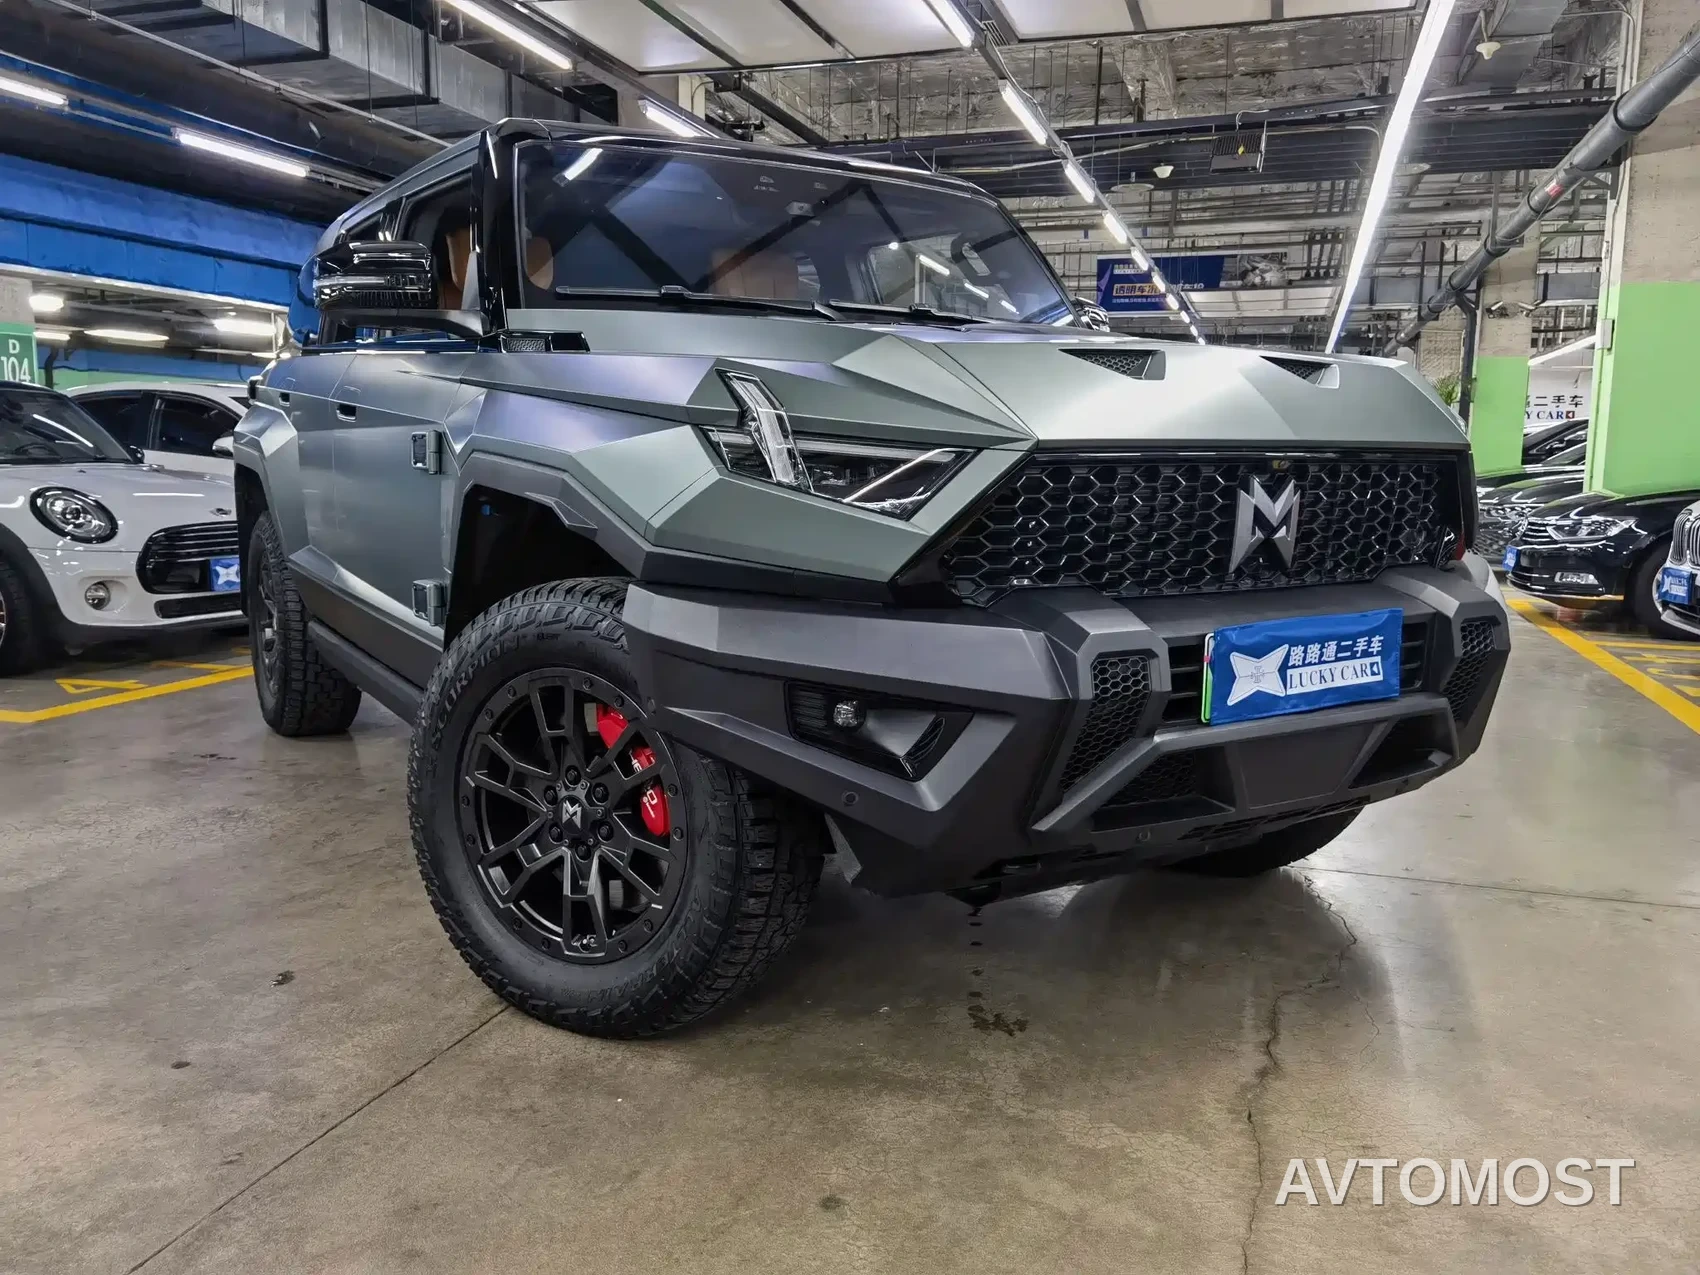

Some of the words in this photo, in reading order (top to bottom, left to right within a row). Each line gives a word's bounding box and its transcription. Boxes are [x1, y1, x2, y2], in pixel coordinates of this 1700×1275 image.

[9, 339, 20, 354] D
[1, 356, 31, 382] 104
[1526, 395, 1583, 408] 二手车
[1537, 411, 1564, 419] CAR
[1288, 635, 1384, 666] 路路通二手车
[1289, 667, 1337, 689] LUCKY
[1340, 663, 1369, 681] CAR
